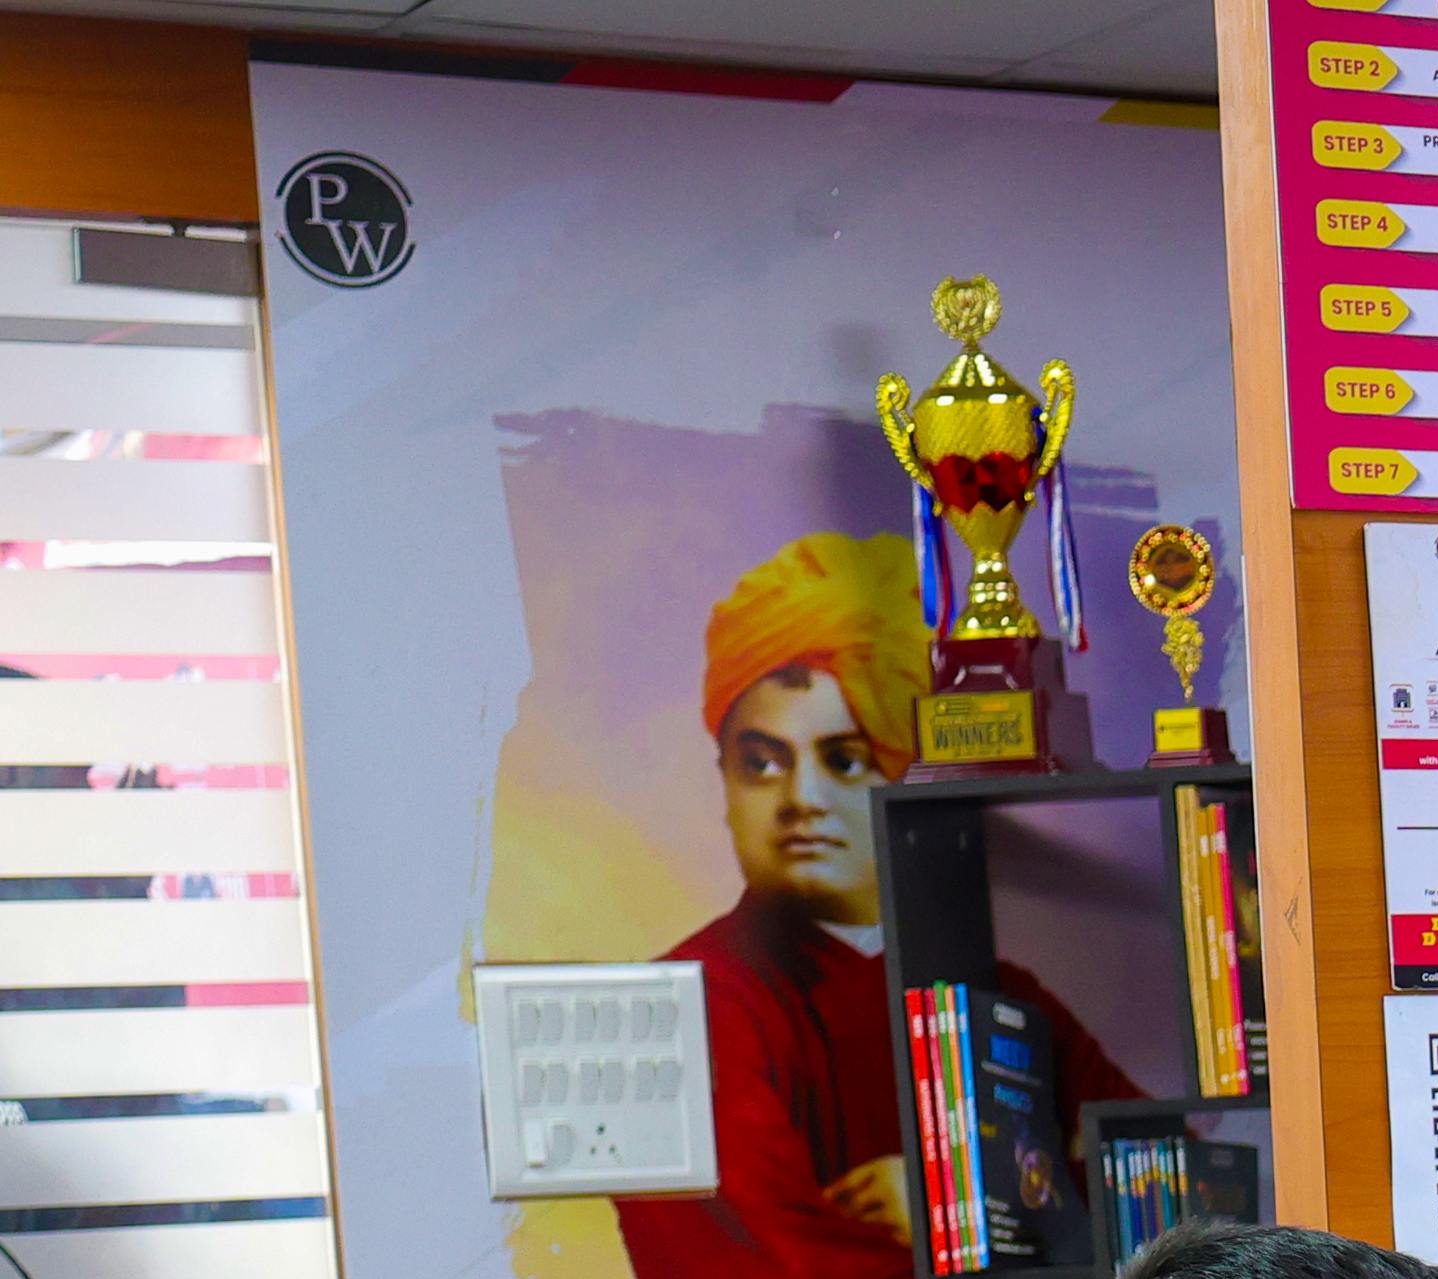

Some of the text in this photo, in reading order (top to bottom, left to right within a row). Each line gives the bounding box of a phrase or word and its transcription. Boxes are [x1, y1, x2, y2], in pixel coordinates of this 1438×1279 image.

[1320, 58, 1380, 76] STEP 2
[1324, 136, 1384, 153] STEP 3
[305, 173, 398, 274] PW
[1327, 215, 1388, 231] STEP 4
[1332, 300, 1391, 316] STEP 5
[1336, 383, 1396, 399] STEP 6
[1341, 463, 1399, 479] STEP 7
[1422, 972, 1438, 981] Call
